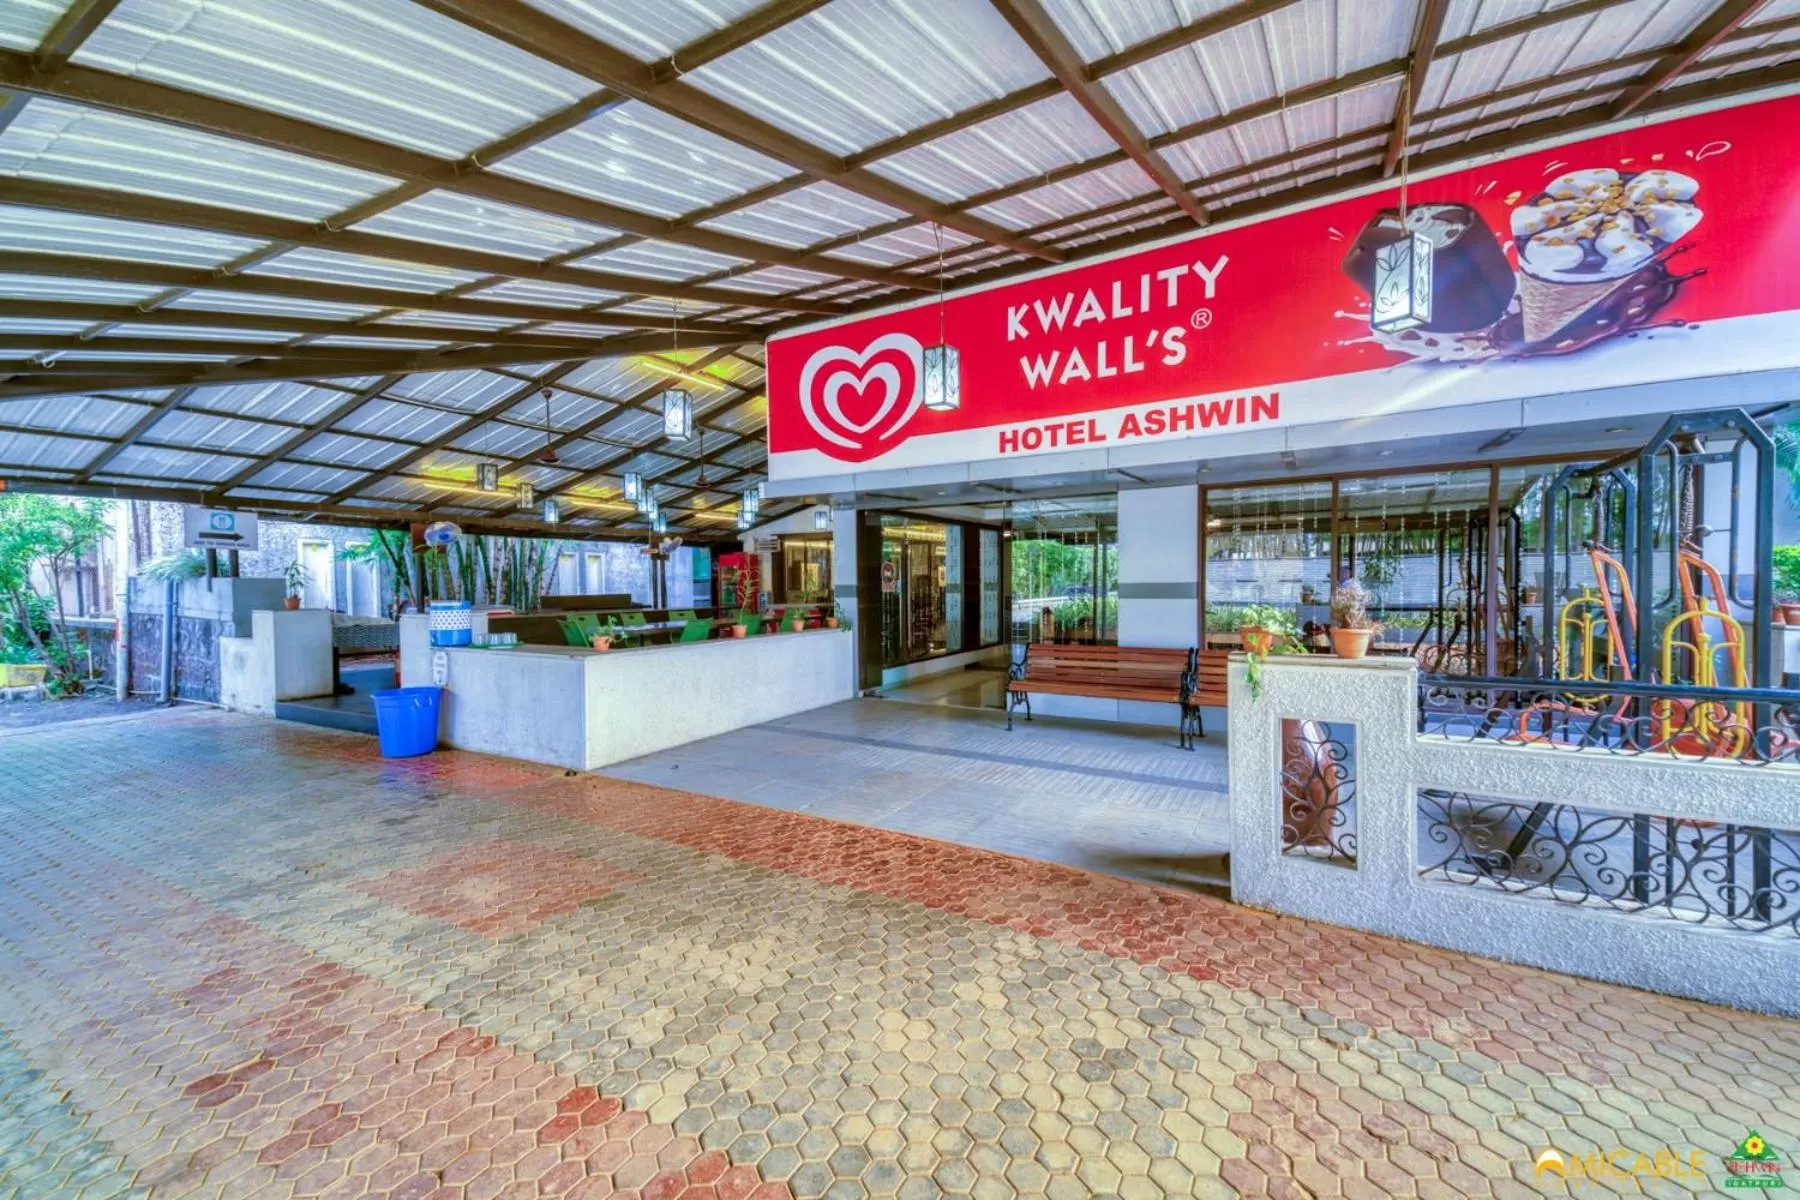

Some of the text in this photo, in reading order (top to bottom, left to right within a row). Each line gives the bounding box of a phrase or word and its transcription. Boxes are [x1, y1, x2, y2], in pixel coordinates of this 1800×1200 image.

[1007, 254, 1230, 342] KWALITY
[1019, 326, 1187, 390] WALL'S
[998, 392, 1280, 453] HOTEL ASHWIN
